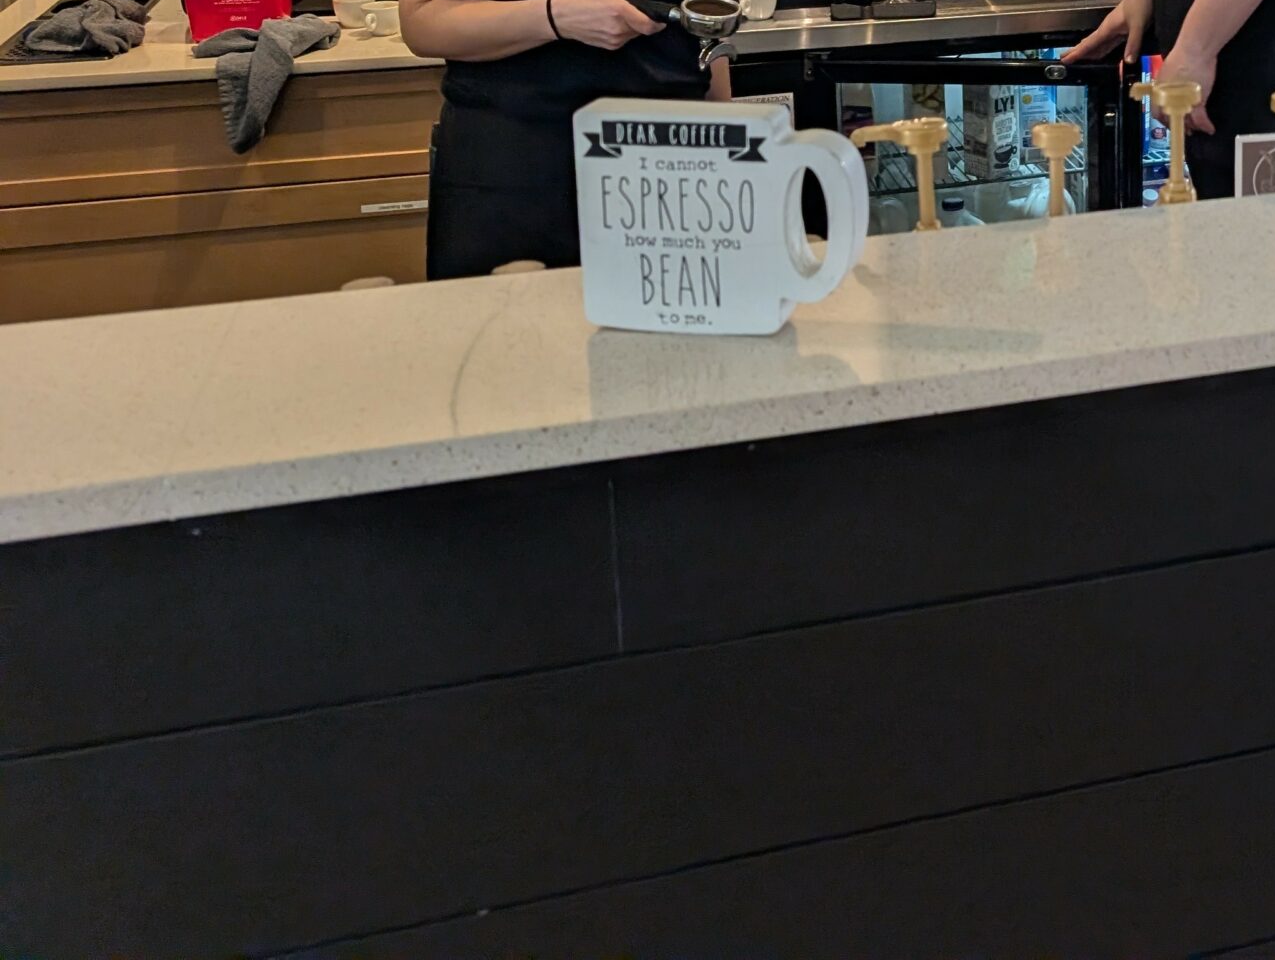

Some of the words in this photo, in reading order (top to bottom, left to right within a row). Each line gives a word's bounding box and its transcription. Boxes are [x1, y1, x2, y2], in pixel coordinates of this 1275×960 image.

[995, 95, 1014, 113] LY!
[616, 123, 656, 144] DEAR
[669, 124, 726, 146] COFFEE
[639, 157, 647, 169] I
[656, 160, 718, 171] cannot
[602, 176, 754, 233] ESPRESSO
[625, 234, 656, 247] how
[663, 236, 705, 248] much
[712, 238, 741, 252] you
[640, 254, 721, 307] BEAN
[660, 314, 678, 325] to
[685, 316, 713, 326] me.
